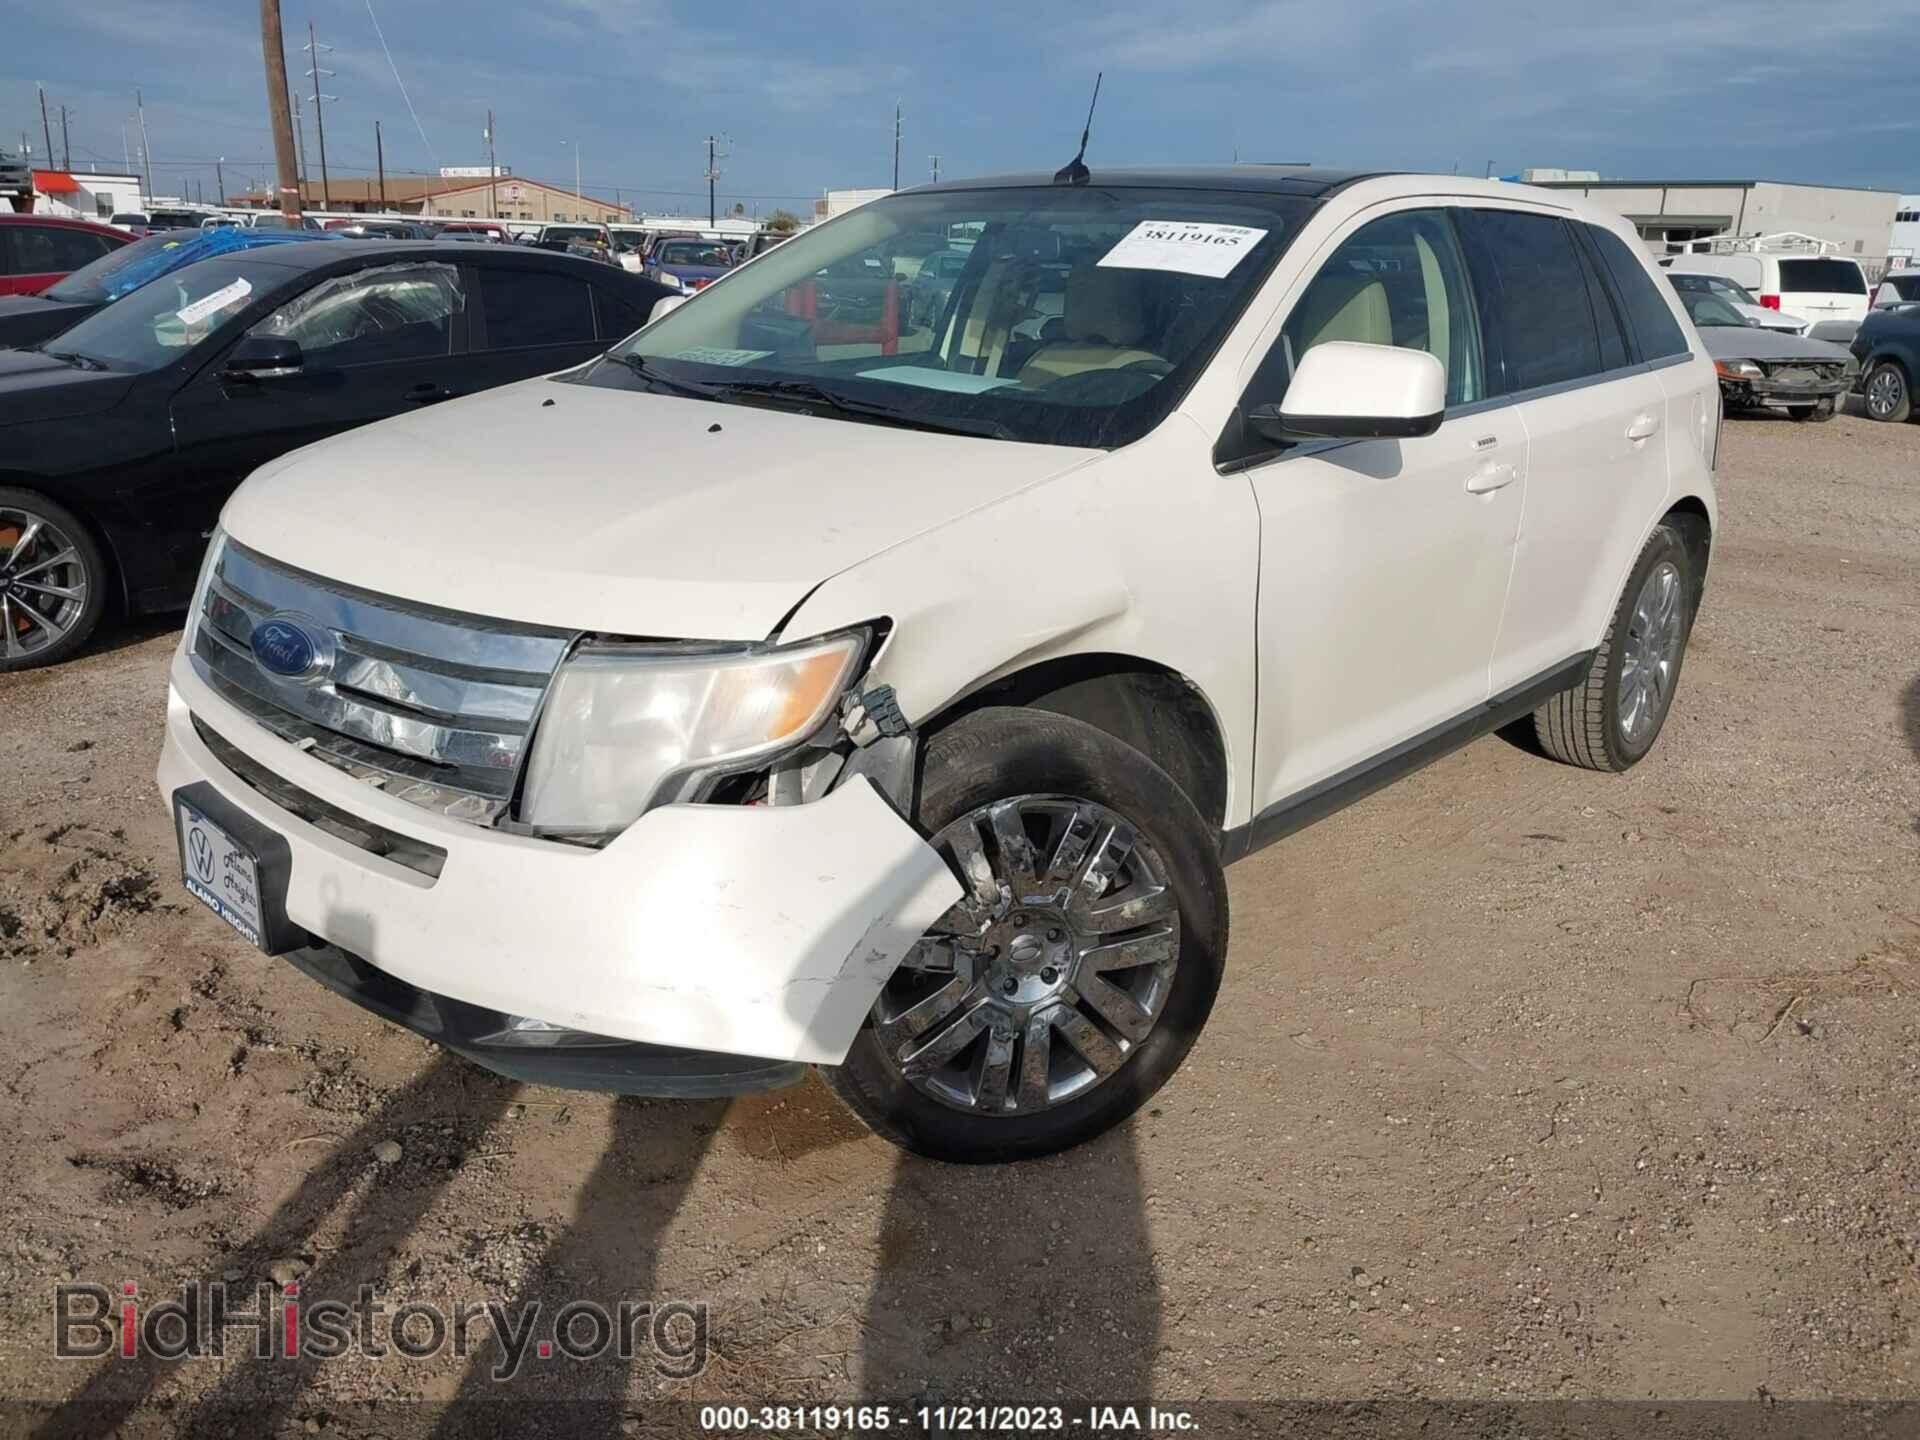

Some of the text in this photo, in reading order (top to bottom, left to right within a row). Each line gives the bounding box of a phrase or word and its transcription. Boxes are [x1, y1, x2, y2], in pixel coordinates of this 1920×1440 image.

[1145, 230, 1241, 246] 38119165
[260, 626, 300, 664] Ford
[186, 880, 219, 912] ALAMO
[221, 907, 259, 946] HEIGHTS
